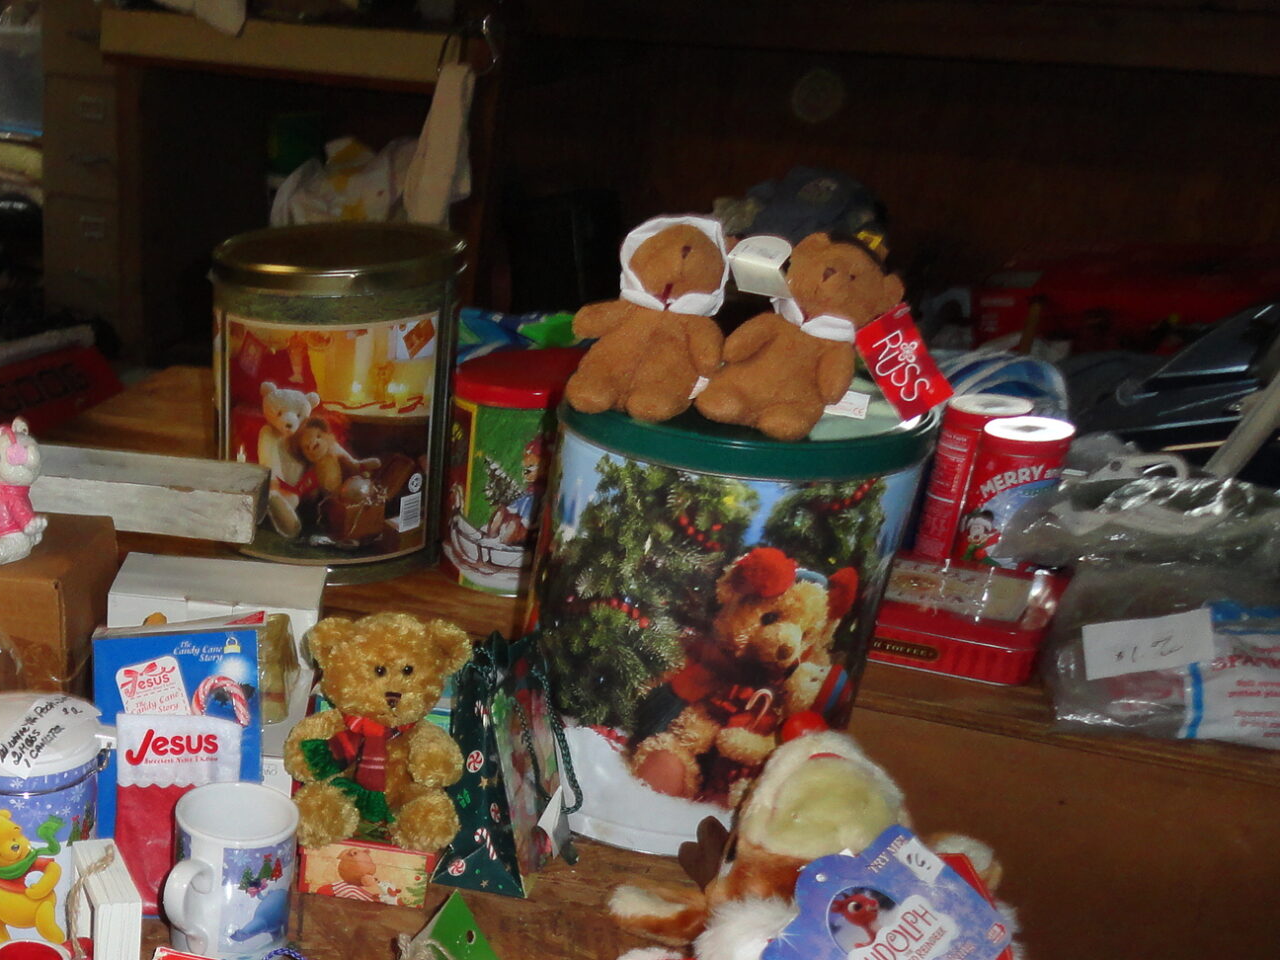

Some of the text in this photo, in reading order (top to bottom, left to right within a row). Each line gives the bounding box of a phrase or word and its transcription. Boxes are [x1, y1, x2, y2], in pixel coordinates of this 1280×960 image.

[872, 329, 930, 402] RUSS
[980, 464, 1045, 498] MERRY
[173, 644, 223, 656] Candy Cane
[198, 653, 225, 663] Story
[125, 729, 219, 766] Jesus
[867, 852, 891, 875] TRY
